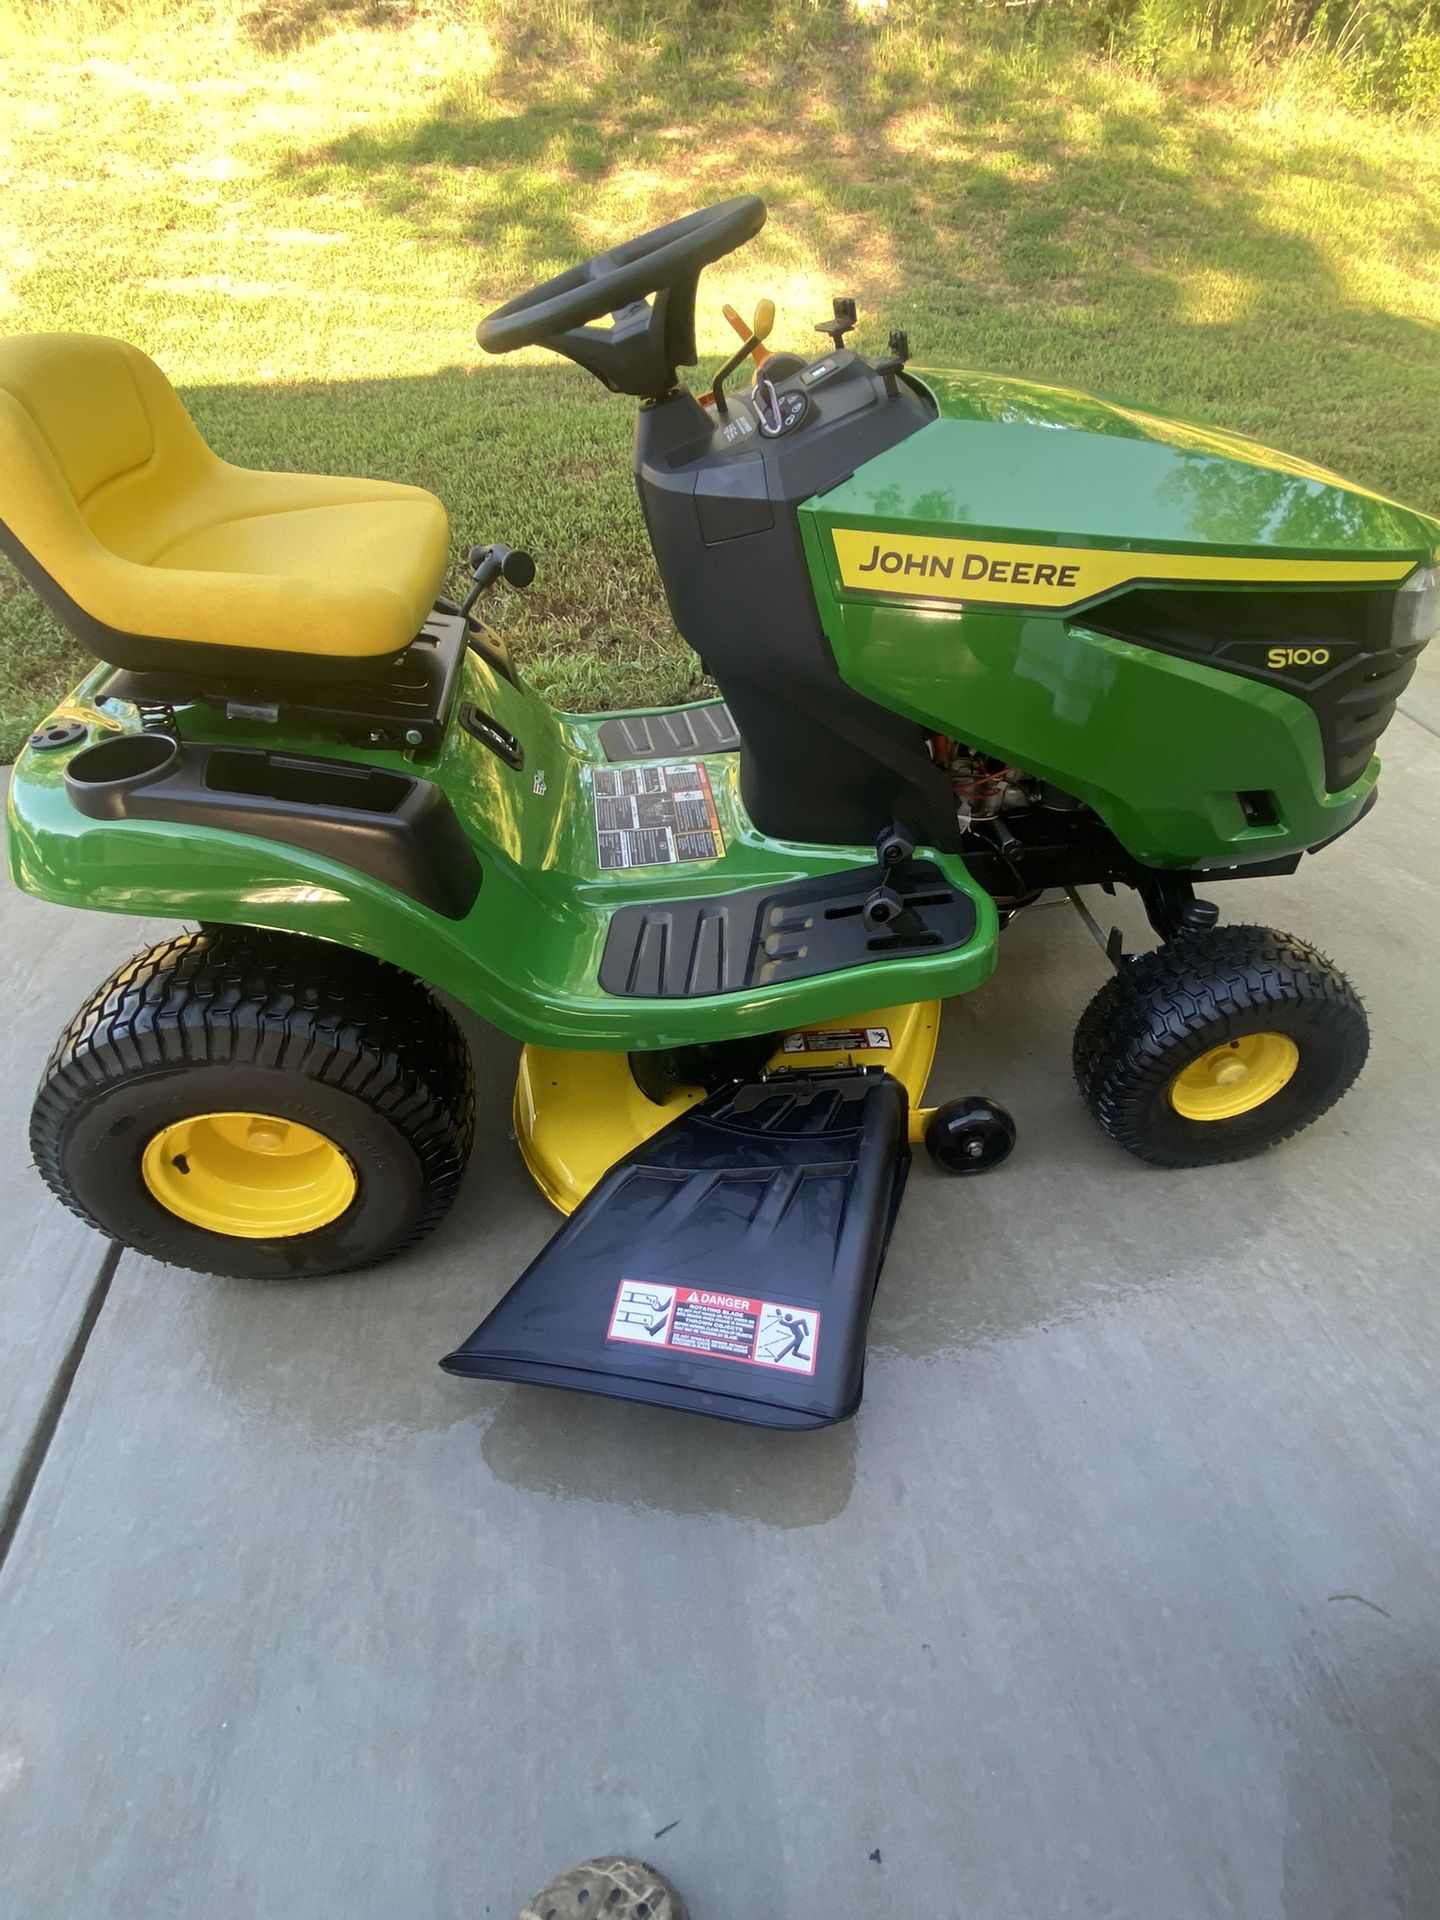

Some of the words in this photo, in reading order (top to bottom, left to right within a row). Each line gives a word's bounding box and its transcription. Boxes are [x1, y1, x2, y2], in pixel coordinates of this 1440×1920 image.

[859, 546, 954, 578] JOHN
[961, 554, 1080, 587] DEERE
[1267, 648, 1330, 669] S100
[689, 1304, 721, 1314] ROTATING
[722, 1308, 744, 1317] BLADE
[700, 1293, 750, 1311] DANGER
[685, 1318, 713, 1327] THROWN
[714, 1322, 744, 1332] OBJECTS
